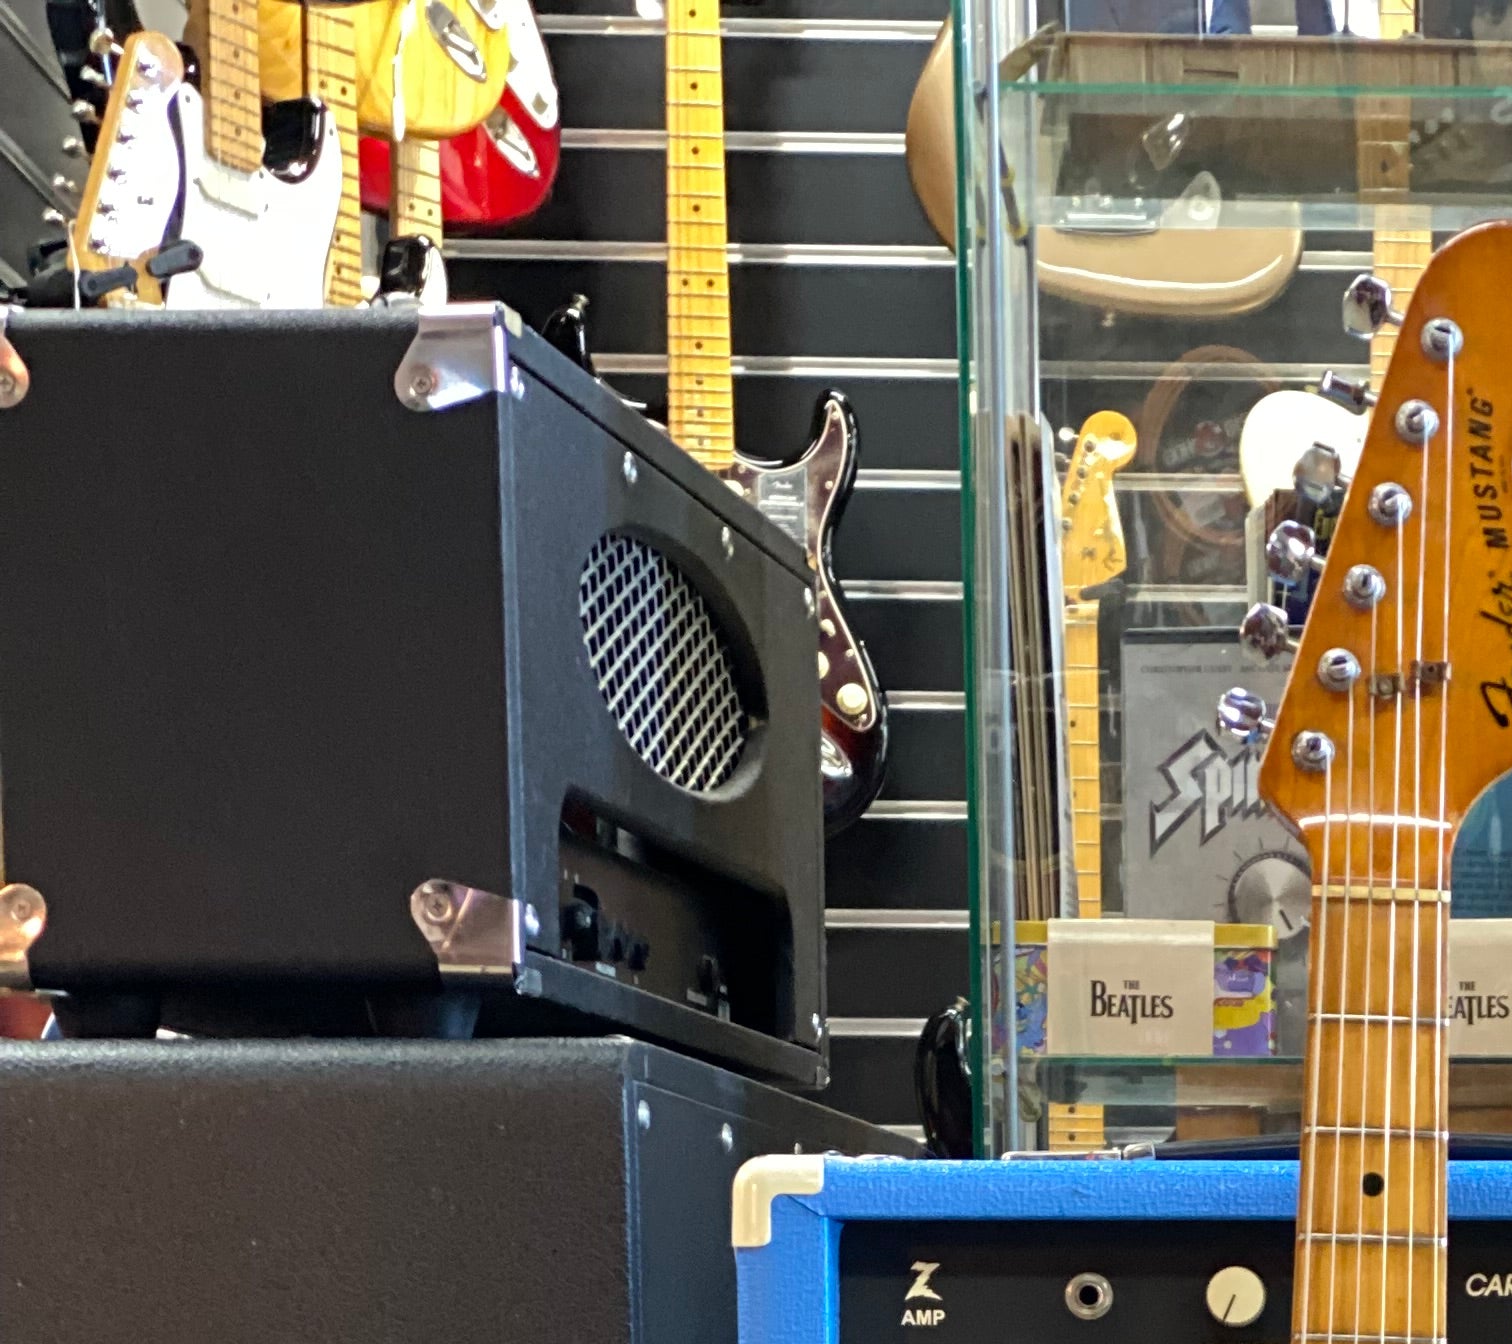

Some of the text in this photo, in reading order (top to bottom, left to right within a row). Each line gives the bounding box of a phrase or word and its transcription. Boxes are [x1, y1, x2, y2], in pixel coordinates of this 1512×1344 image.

[1467, 397, 1510, 550] MUSTANG
[1123, 979, 1140, 990] THE
[1459, 981, 1476, 991] THE
[1090, 979, 1174, 1025] BEATLES
[900, 1309, 946, 1326] AMP
